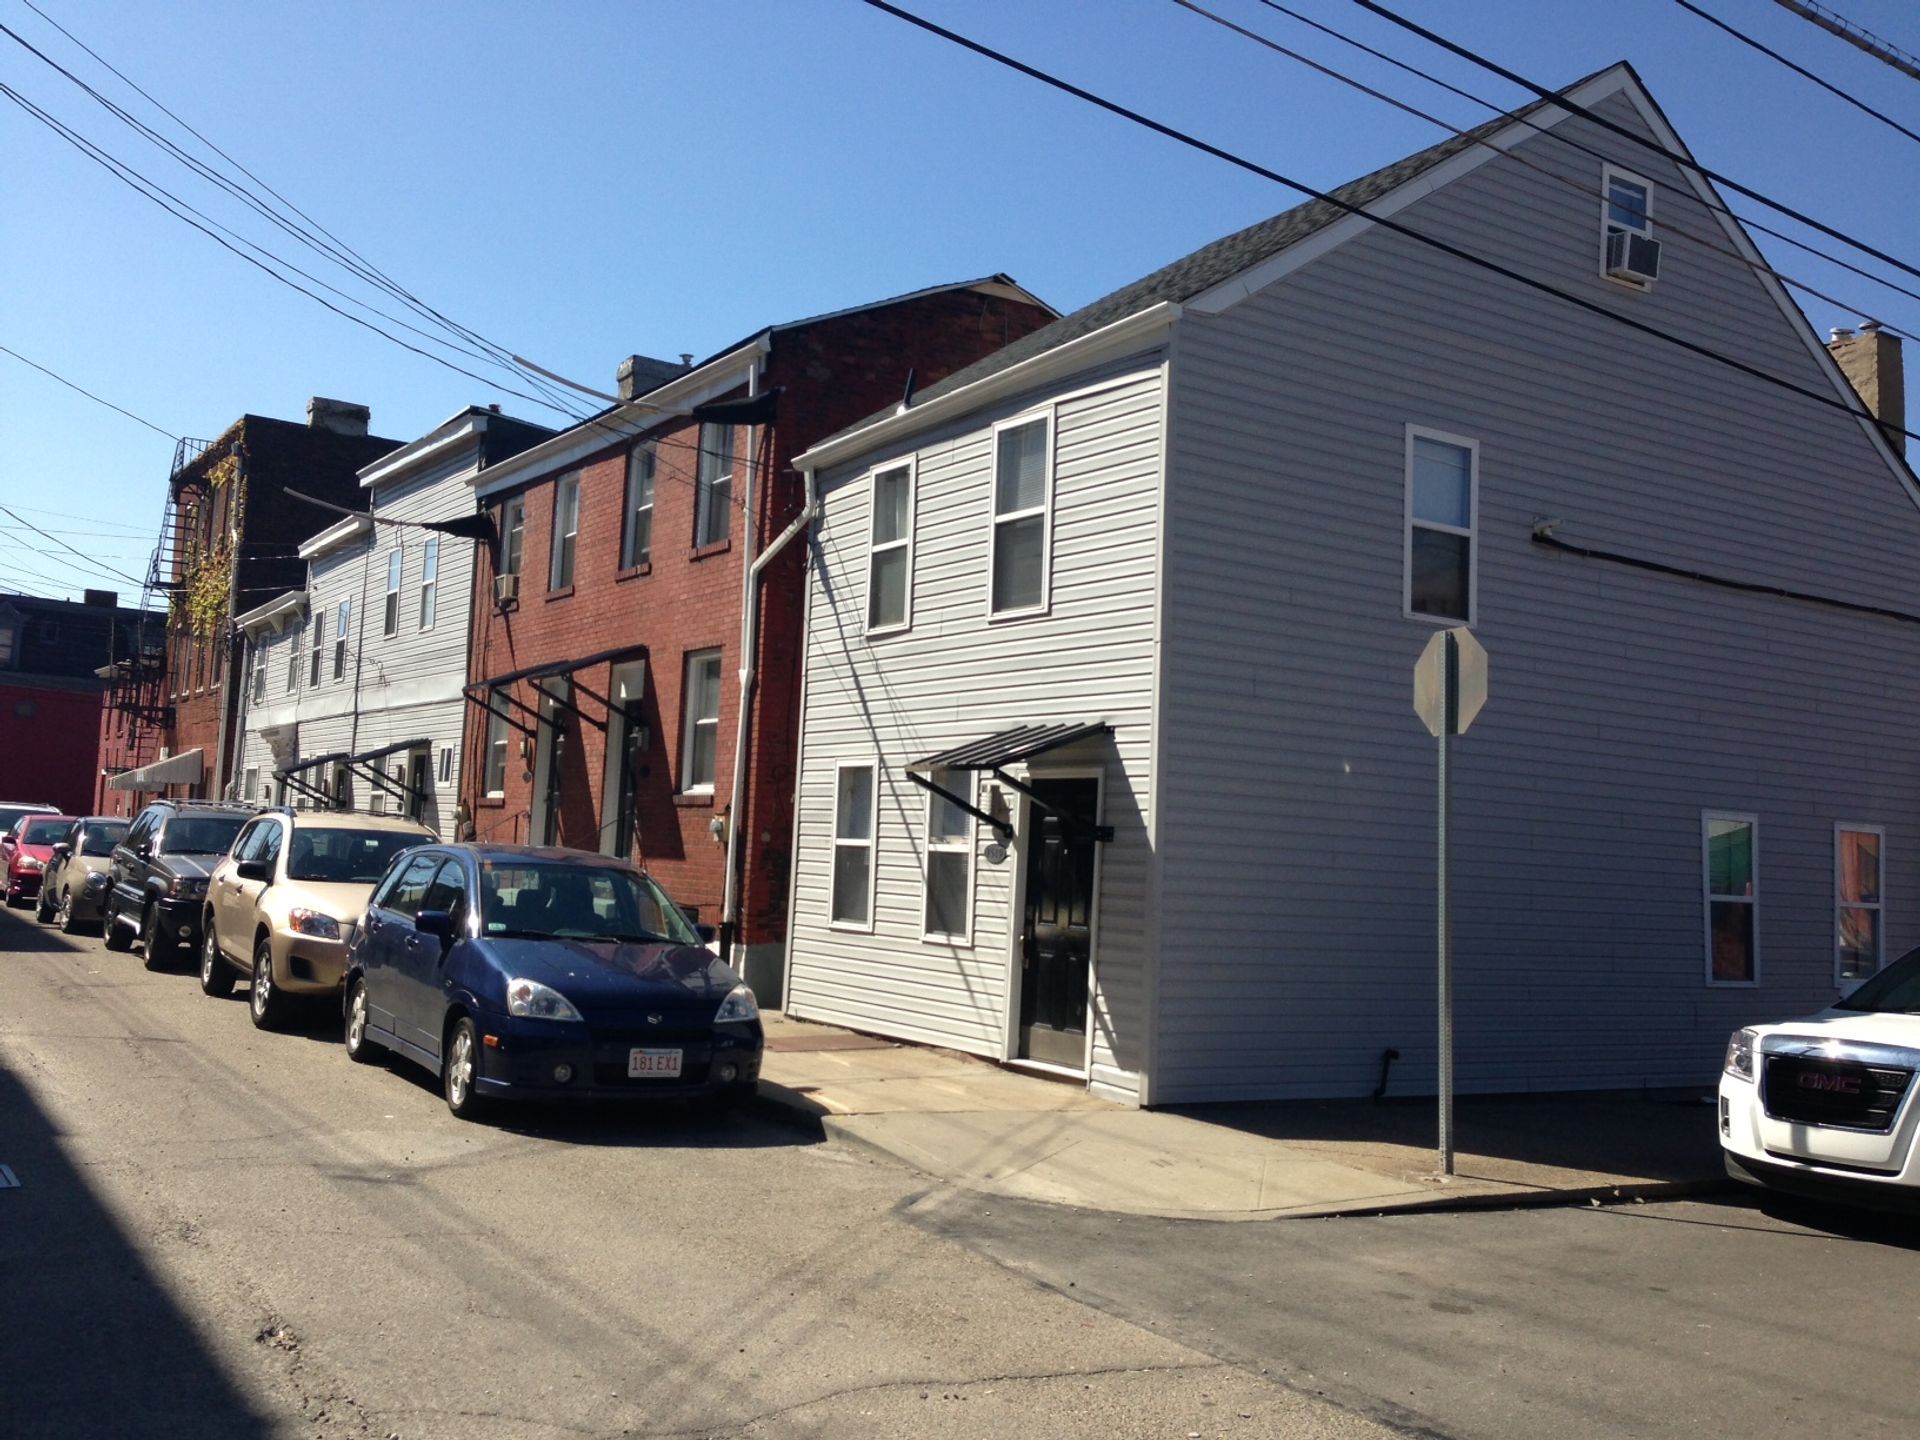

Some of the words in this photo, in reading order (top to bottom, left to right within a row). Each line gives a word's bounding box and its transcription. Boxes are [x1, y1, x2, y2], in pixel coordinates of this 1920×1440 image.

[632, 1056, 653, 1071] 181
[657, 1056, 679, 1071] EX1
[1797, 1071, 1862, 1095] GMC
